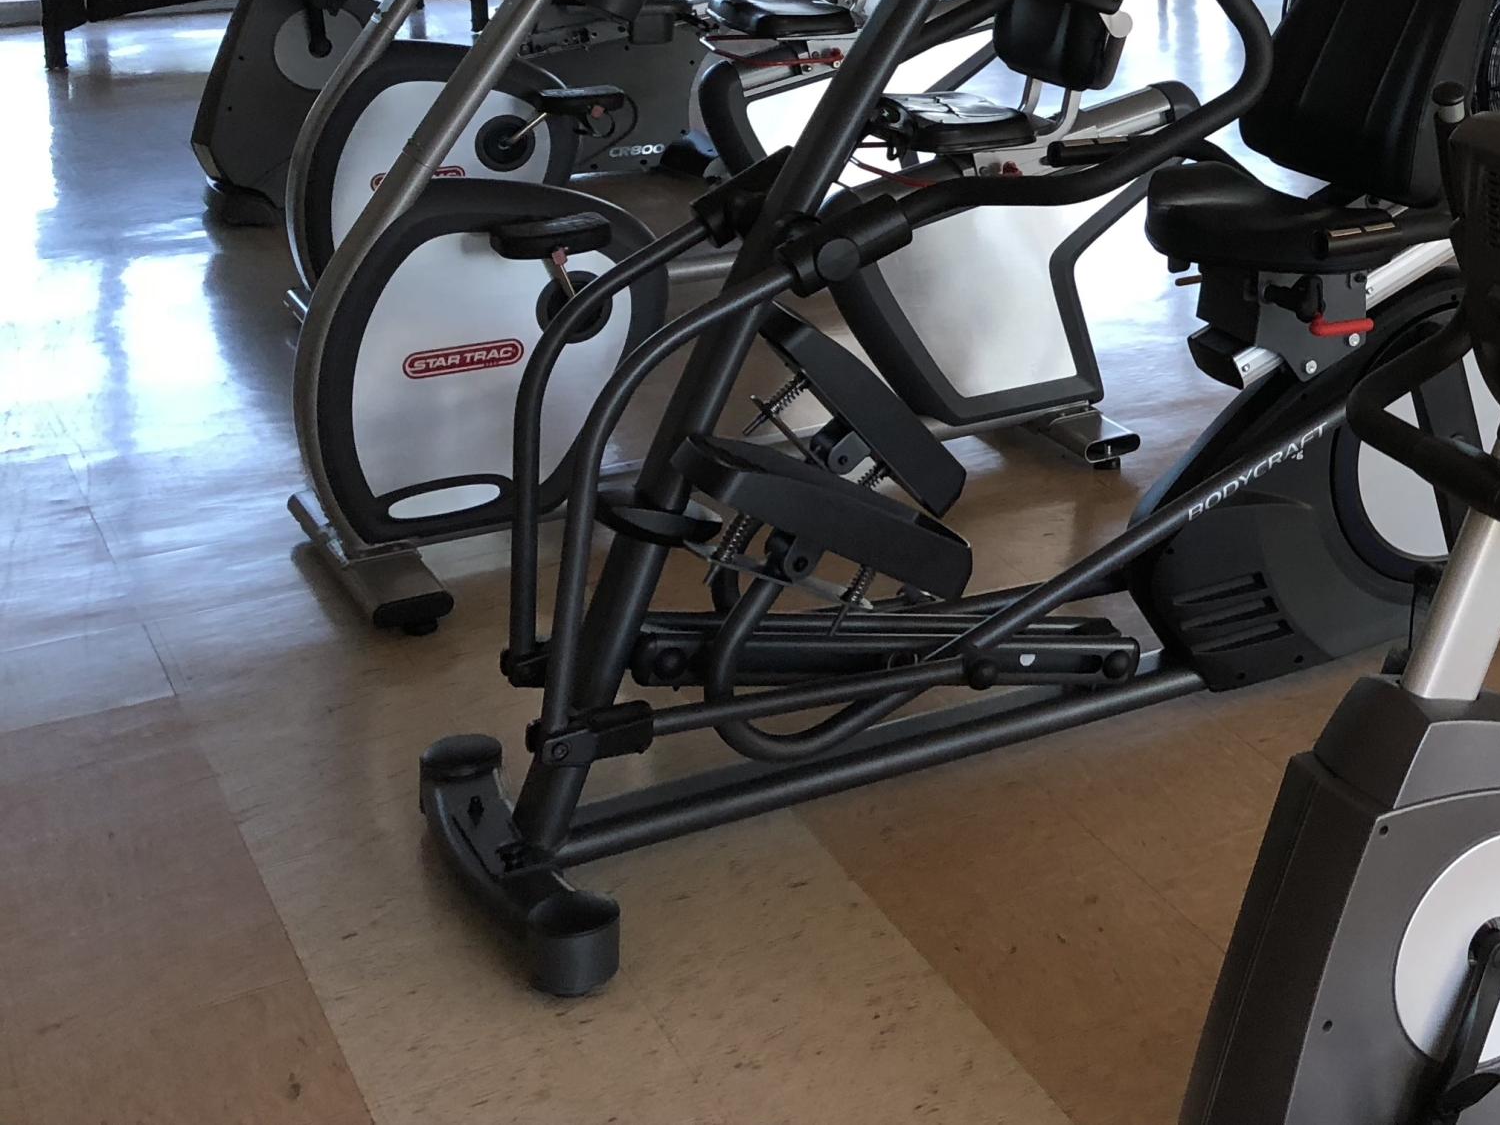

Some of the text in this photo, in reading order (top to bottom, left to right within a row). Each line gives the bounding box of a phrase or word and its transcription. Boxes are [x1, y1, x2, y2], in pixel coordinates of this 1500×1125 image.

[608, 143, 665, 158] CR800
[410, 346, 513, 372] STAR TRAC
[1188, 422, 1328, 522] BODYCRAFT
